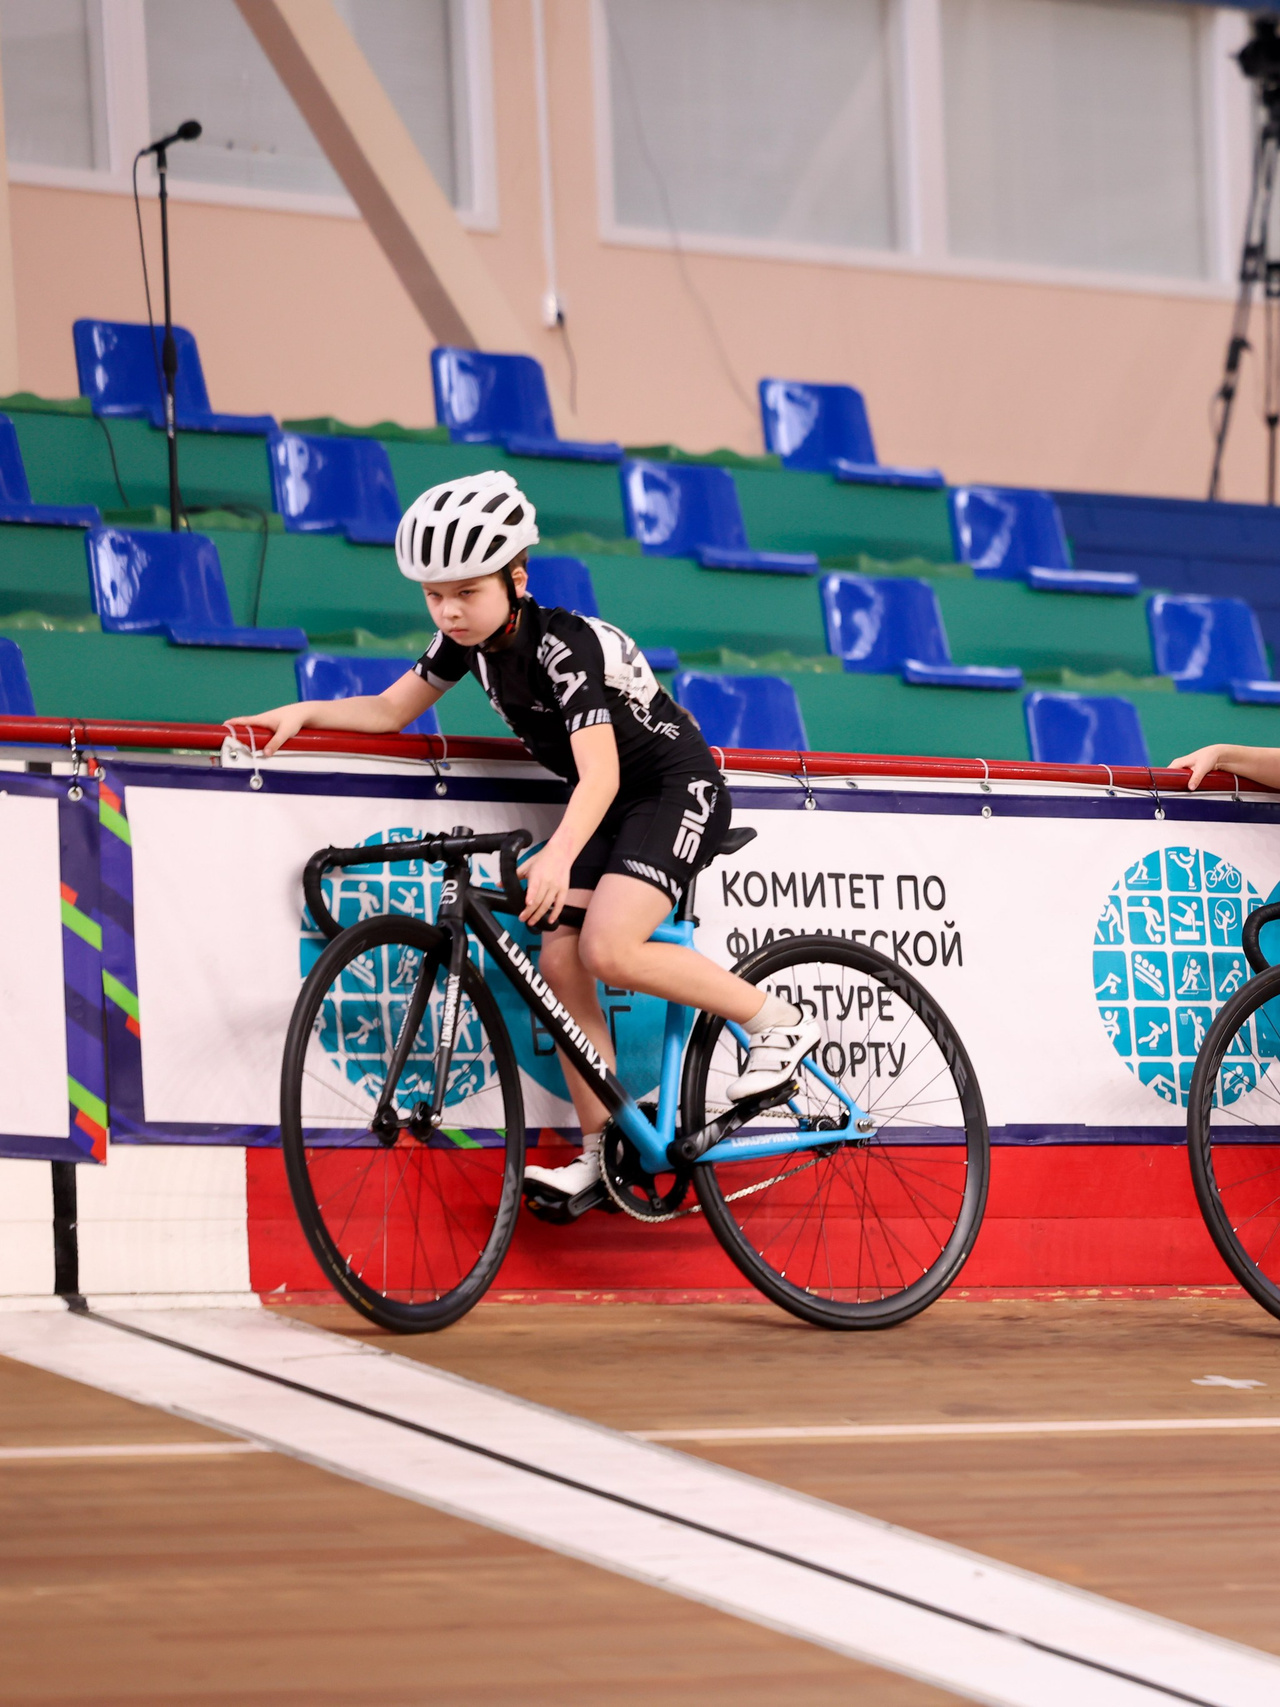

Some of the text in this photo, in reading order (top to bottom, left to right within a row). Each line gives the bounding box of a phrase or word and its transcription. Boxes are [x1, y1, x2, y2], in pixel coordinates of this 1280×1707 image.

[721, 870, 946, 911] КОМИТЕТ ПО
[440, 973, 460, 1049] LOKOSPHINX
[497, 930, 609, 1081] LOKOSPHINX
